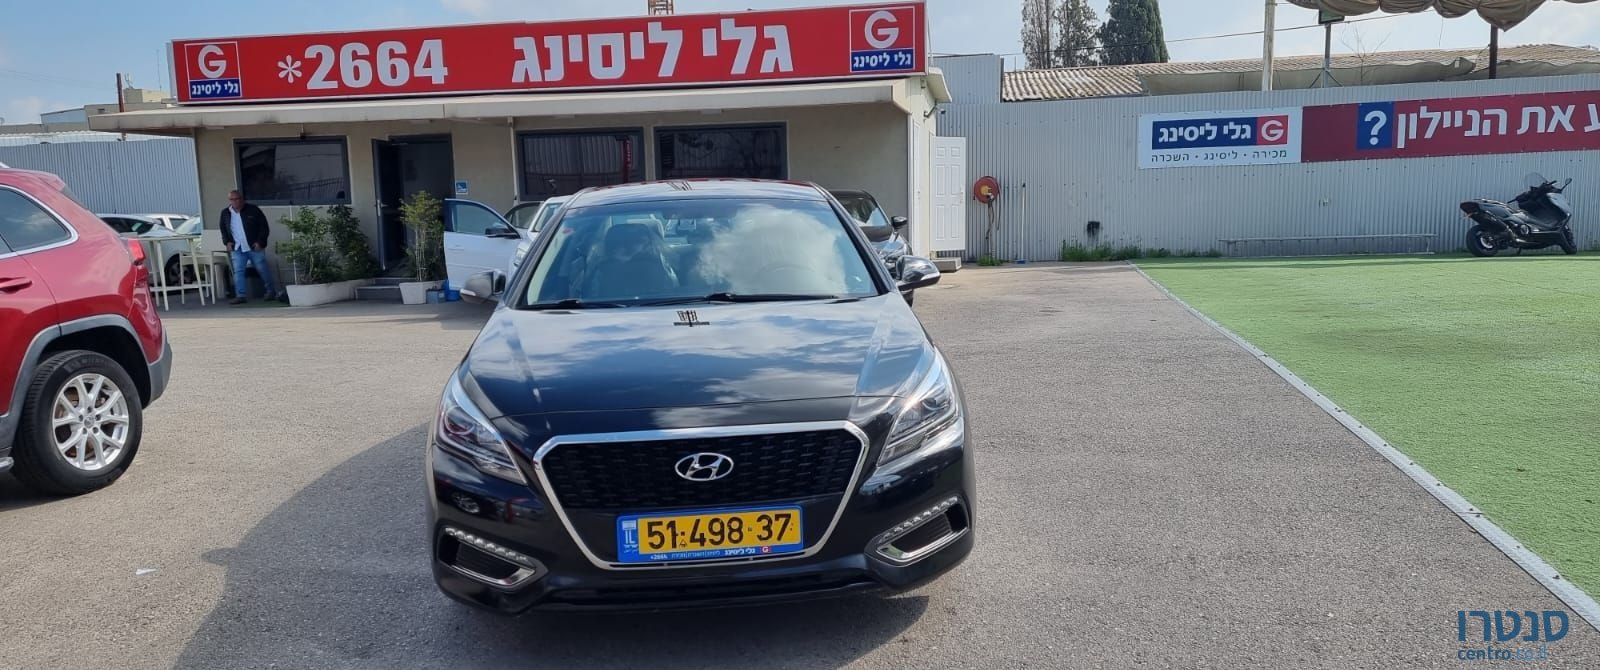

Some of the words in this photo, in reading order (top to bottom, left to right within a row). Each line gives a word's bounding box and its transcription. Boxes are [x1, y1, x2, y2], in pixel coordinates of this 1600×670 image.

[864, 10, 899, 49] G
[511, 21, 683, 84] ליסינג
[702, 18, 794, 75] גלי
[197, 44, 228, 79] G
[852, 53, 891, 69] ליסינג
[893, 51, 912, 66] גלי
[191, 81, 222, 95] ליסינג
[223, 81, 239, 94] גלי
[1396, 106, 1508, 149] הניילון
[1516, 104, 1576, 136] את
[1158, 122, 1218, 143] ליסינג
[1222, 121, 1252, 141] גלי
[1261, 119, 1284, 142] G
[1151, 152, 1190, 163] השכרה
[1203, 150, 1238, 161] ליסינג
[1252, 149, 1288, 160] מכירה
